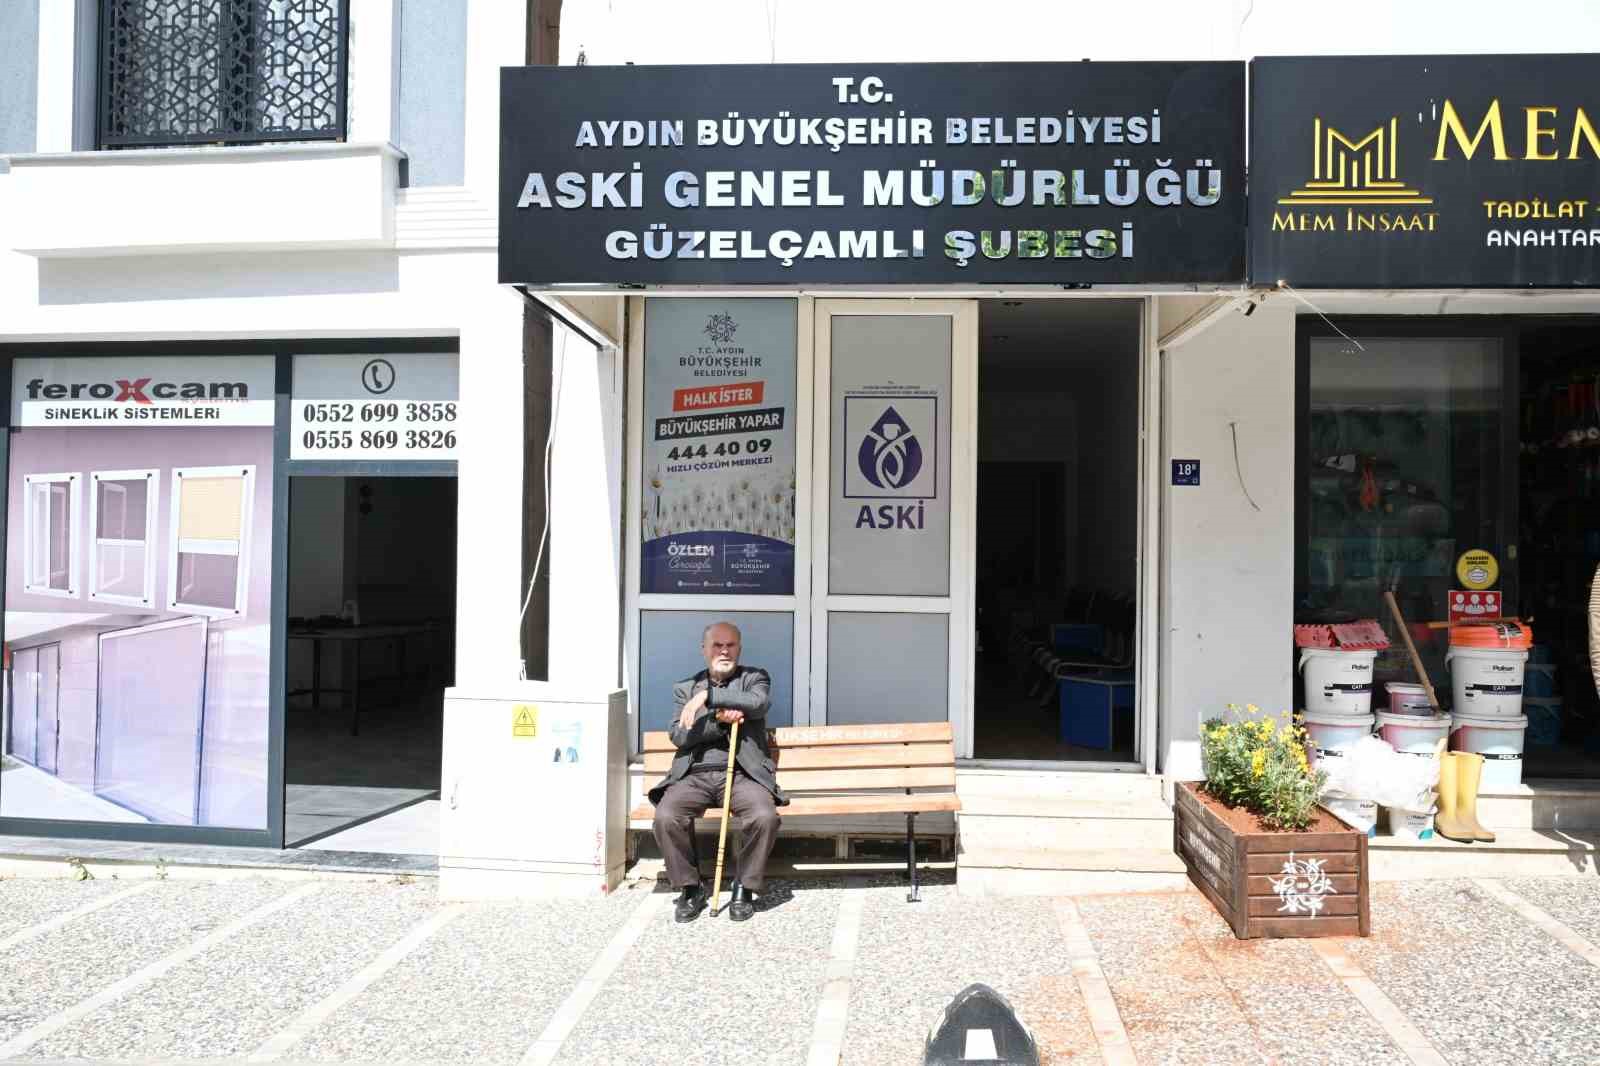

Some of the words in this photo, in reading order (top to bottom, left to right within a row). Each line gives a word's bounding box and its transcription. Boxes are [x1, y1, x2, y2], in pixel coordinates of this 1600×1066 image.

[832, 76, 893, 104] T.C.
[575, 120, 684, 147] AYDIN
[697, 110, 934, 152] BÜYÜKŞEHİR
[945, 108, 1161, 145] BELEDİYESİ
[516, 161, 644, 209] ASKİ
[664, 170, 845, 209] GENEL
[862, 158, 1222, 207] MÜDÜRLÜĞÜ
[1482, 197, 1589, 218] TADİLAT
[1272, 210, 1336, 231] MEM
[605, 223, 925, 267] GÜZELÇAMLI
[943, 221, 1134, 267] ŞUBESİ
[679, 355, 762, 368] BÜYÜKŞEHİR
[716, 347, 744, 355] AYDIN
[694, 368, 748, 377] BELEDİYESİ
[683, 391, 718, 407] HALK
[719, 387, 753, 403] İSTER
[303, 403, 354, 423] 0552
[360, 402, 399, 423] 699
[405, 402, 458, 422] 3858
[659, 414, 736, 436] BÜYÜKŞEHİR
[739, 412, 780, 429] YAPAR
[303, 430, 353, 449] 0555
[360, 429, 398, 449] 869
[405, 429, 458, 449] 3826
[667, 444, 708, 461] 444
[713, 441, 740, 456] 40
[746, 438, 772, 454] 09
[667, 463, 692, 473] HIZLI
[694, 459, 730, 472] ÇÖZÜM
[731, 455, 773, 467] MERKEZİ
[855, 500, 925, 530] ASKİ
[667, 541, 715, 557] ÖZLEM
